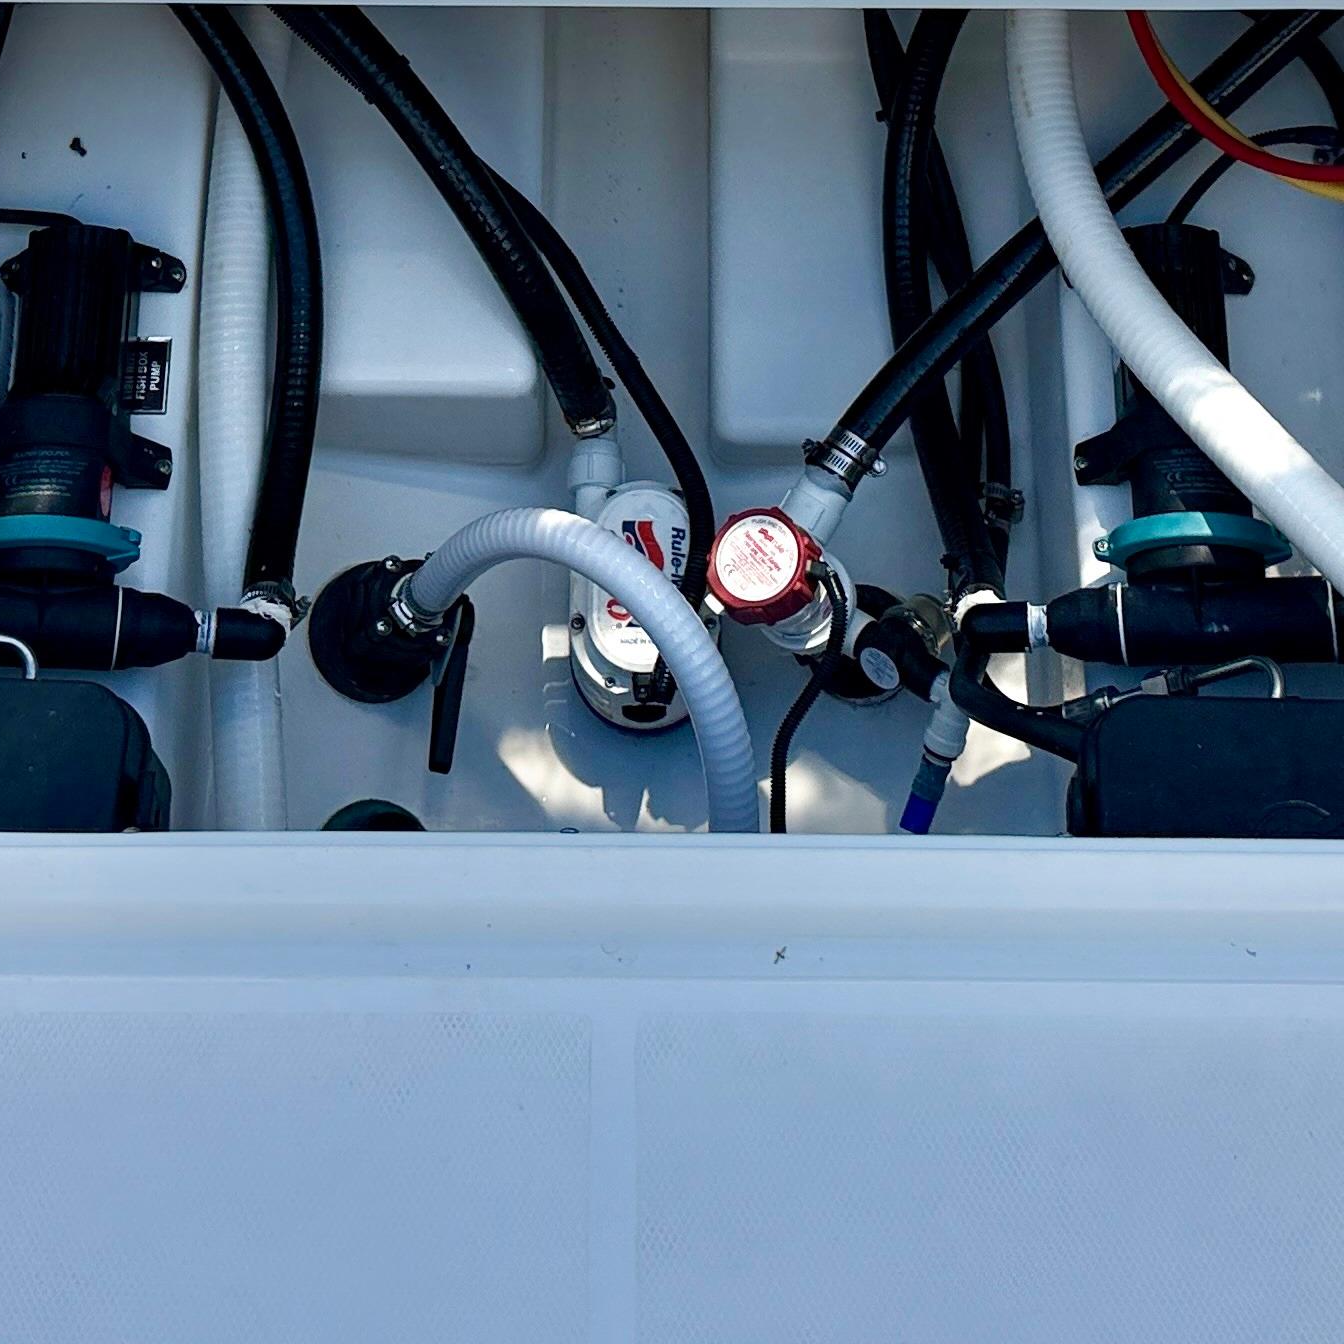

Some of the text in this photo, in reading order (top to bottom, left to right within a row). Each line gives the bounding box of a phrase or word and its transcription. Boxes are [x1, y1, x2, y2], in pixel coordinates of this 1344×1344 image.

[136, 351, 148, 400] FISH BOX
[149, 361, 161, 391] PUMP
